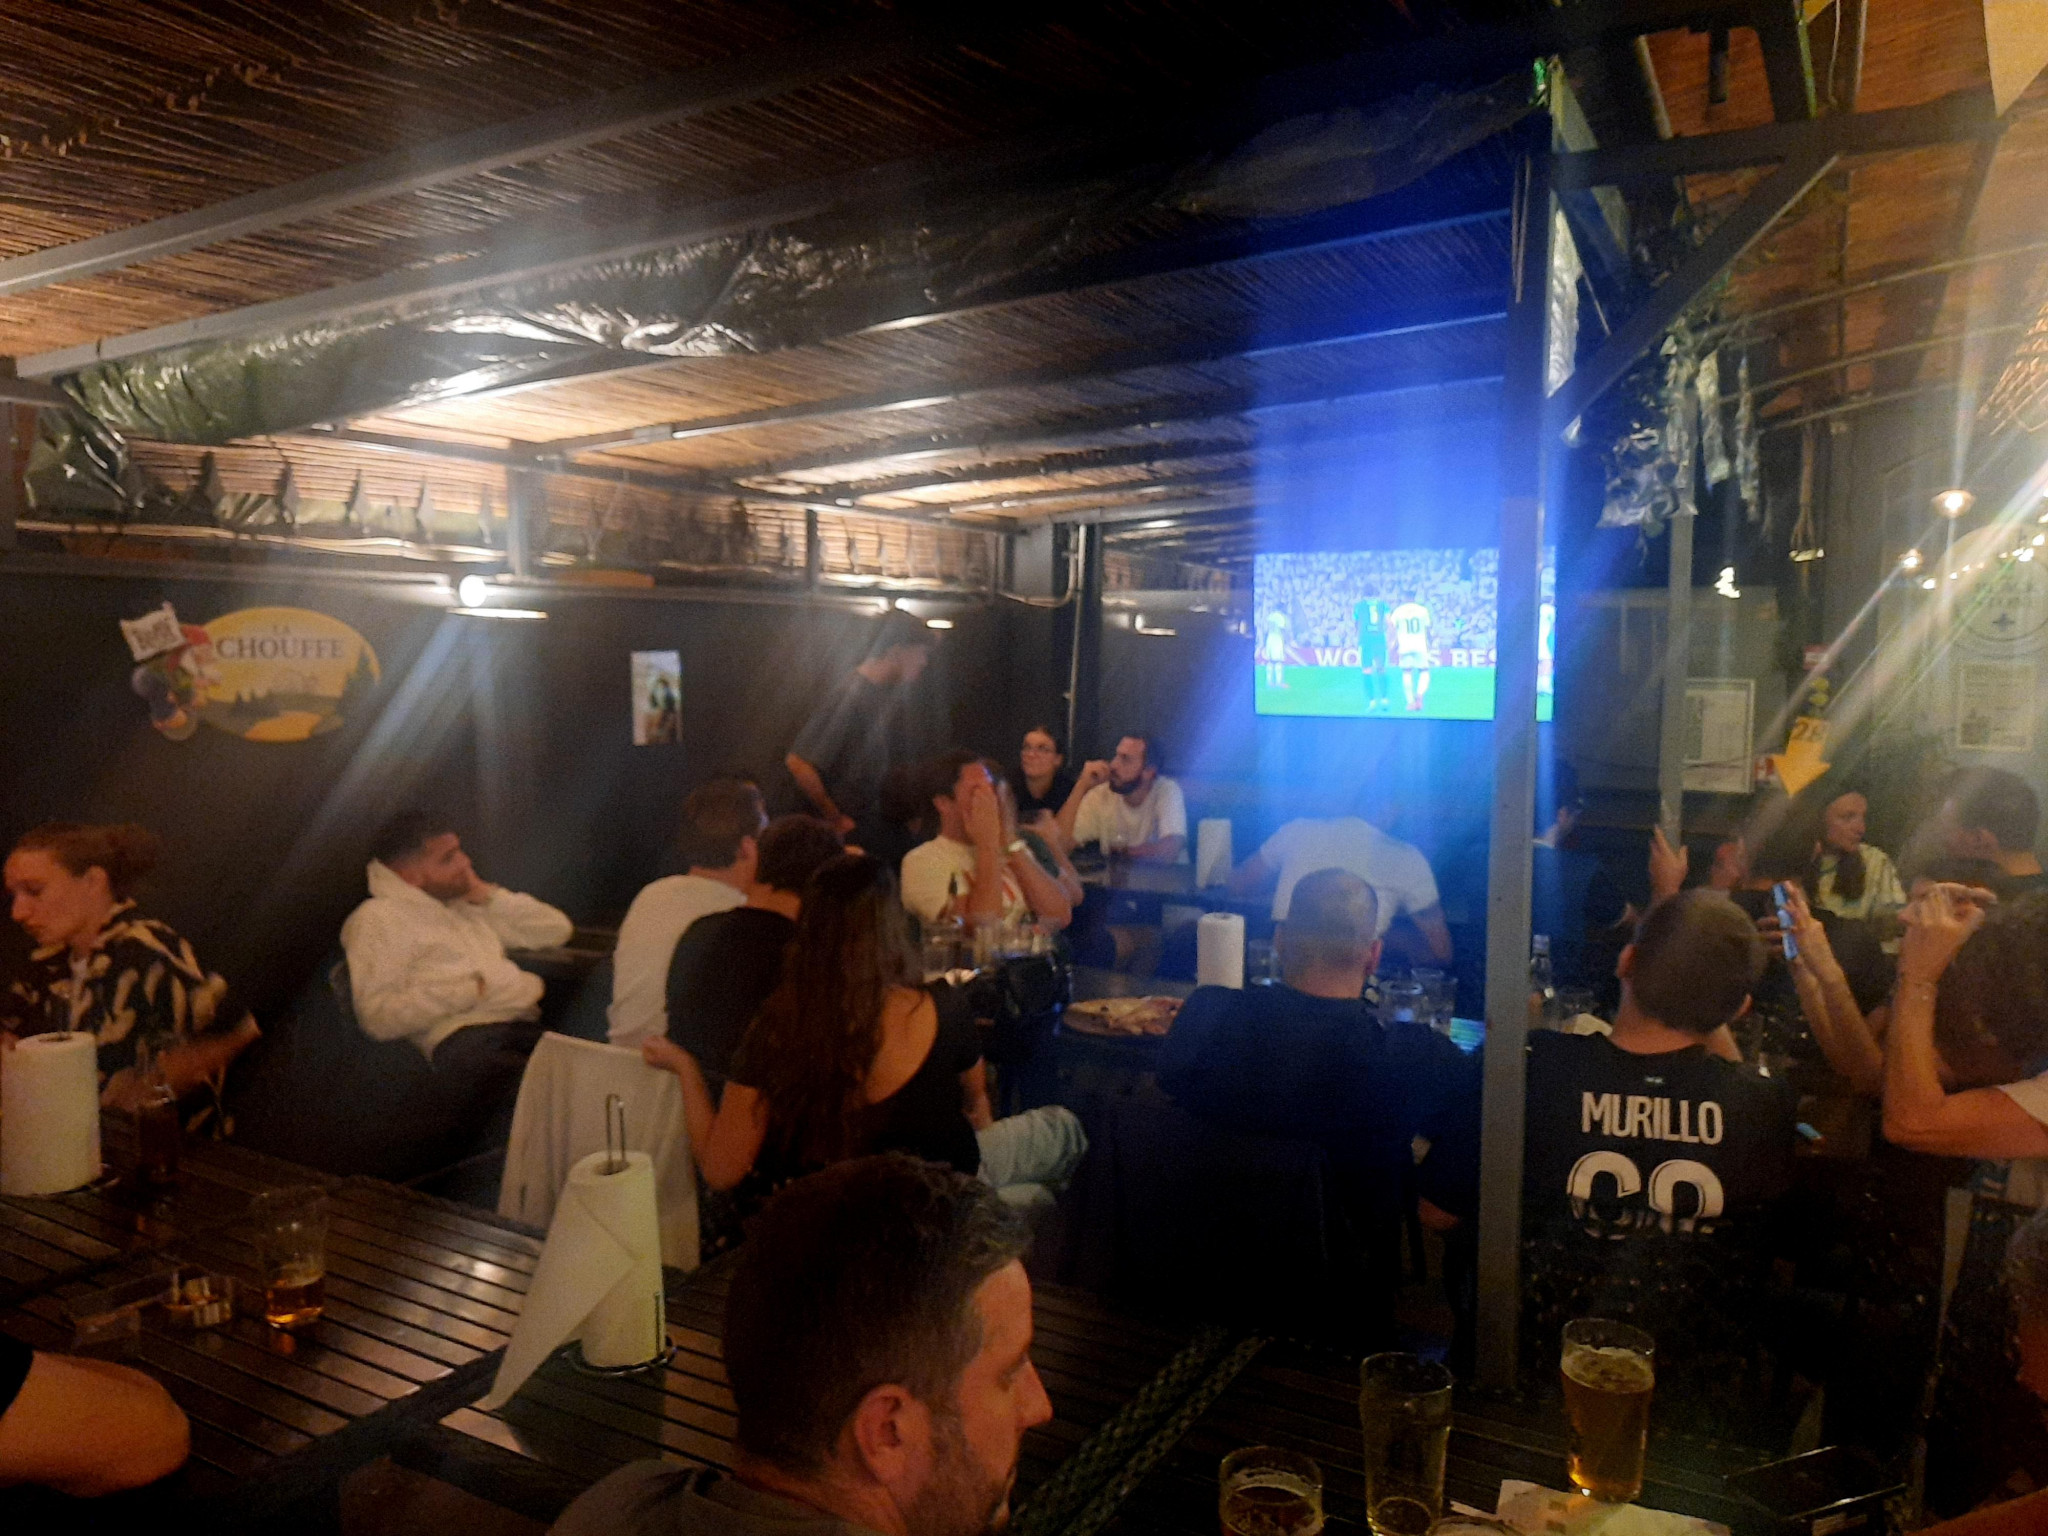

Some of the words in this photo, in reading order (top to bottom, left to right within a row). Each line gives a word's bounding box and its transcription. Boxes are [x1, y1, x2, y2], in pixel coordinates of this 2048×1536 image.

[1405, 617, 1420, 634] 10
[215, 637, 344, 659] CHOUFFE
[1581, 1091, 1724, 1145] MURILLO
